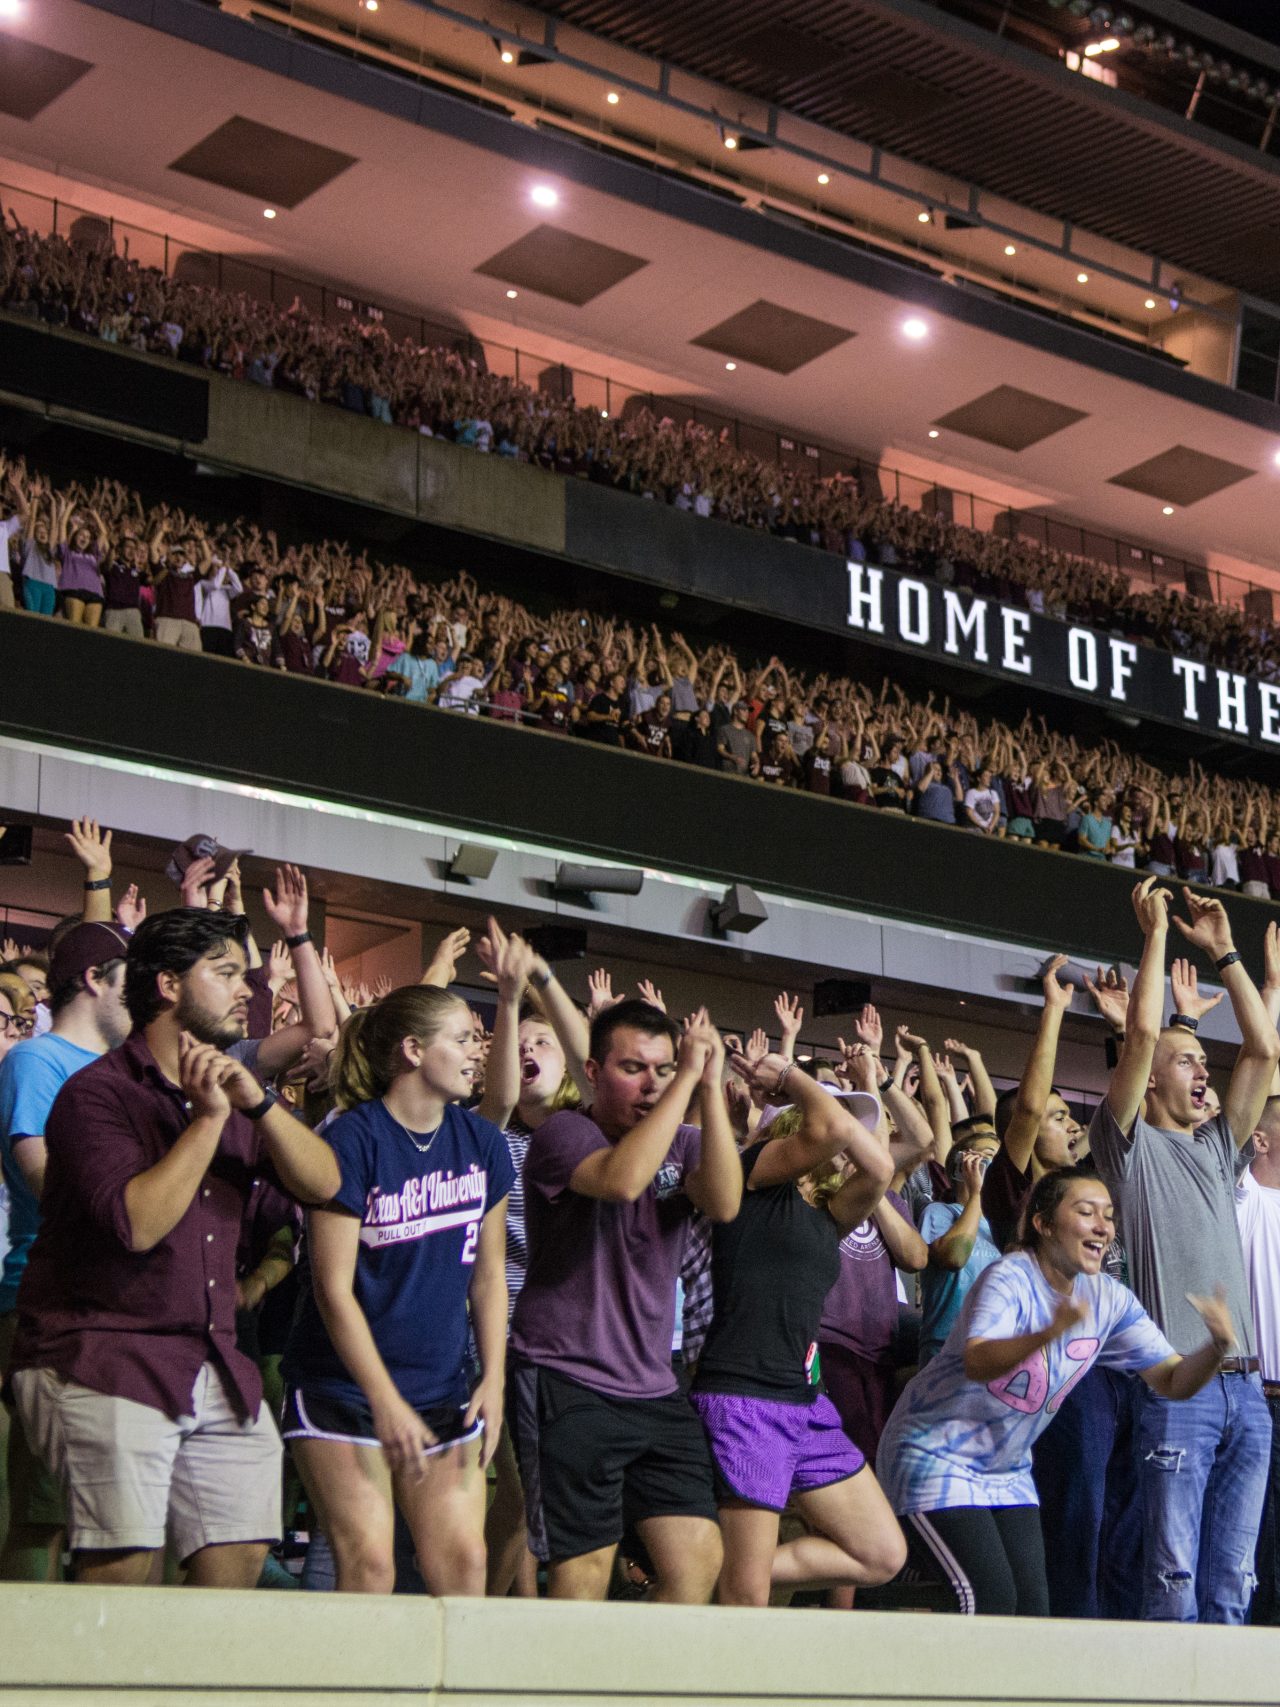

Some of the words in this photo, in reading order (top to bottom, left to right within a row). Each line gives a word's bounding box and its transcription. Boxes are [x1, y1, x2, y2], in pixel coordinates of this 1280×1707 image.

[848, 561, 1031, 674] HOME
[1069, 628, 1137, 700] OF
[378, 1228, 400, 1241] PULL
[404, 1223, 421, 1237] OUT
